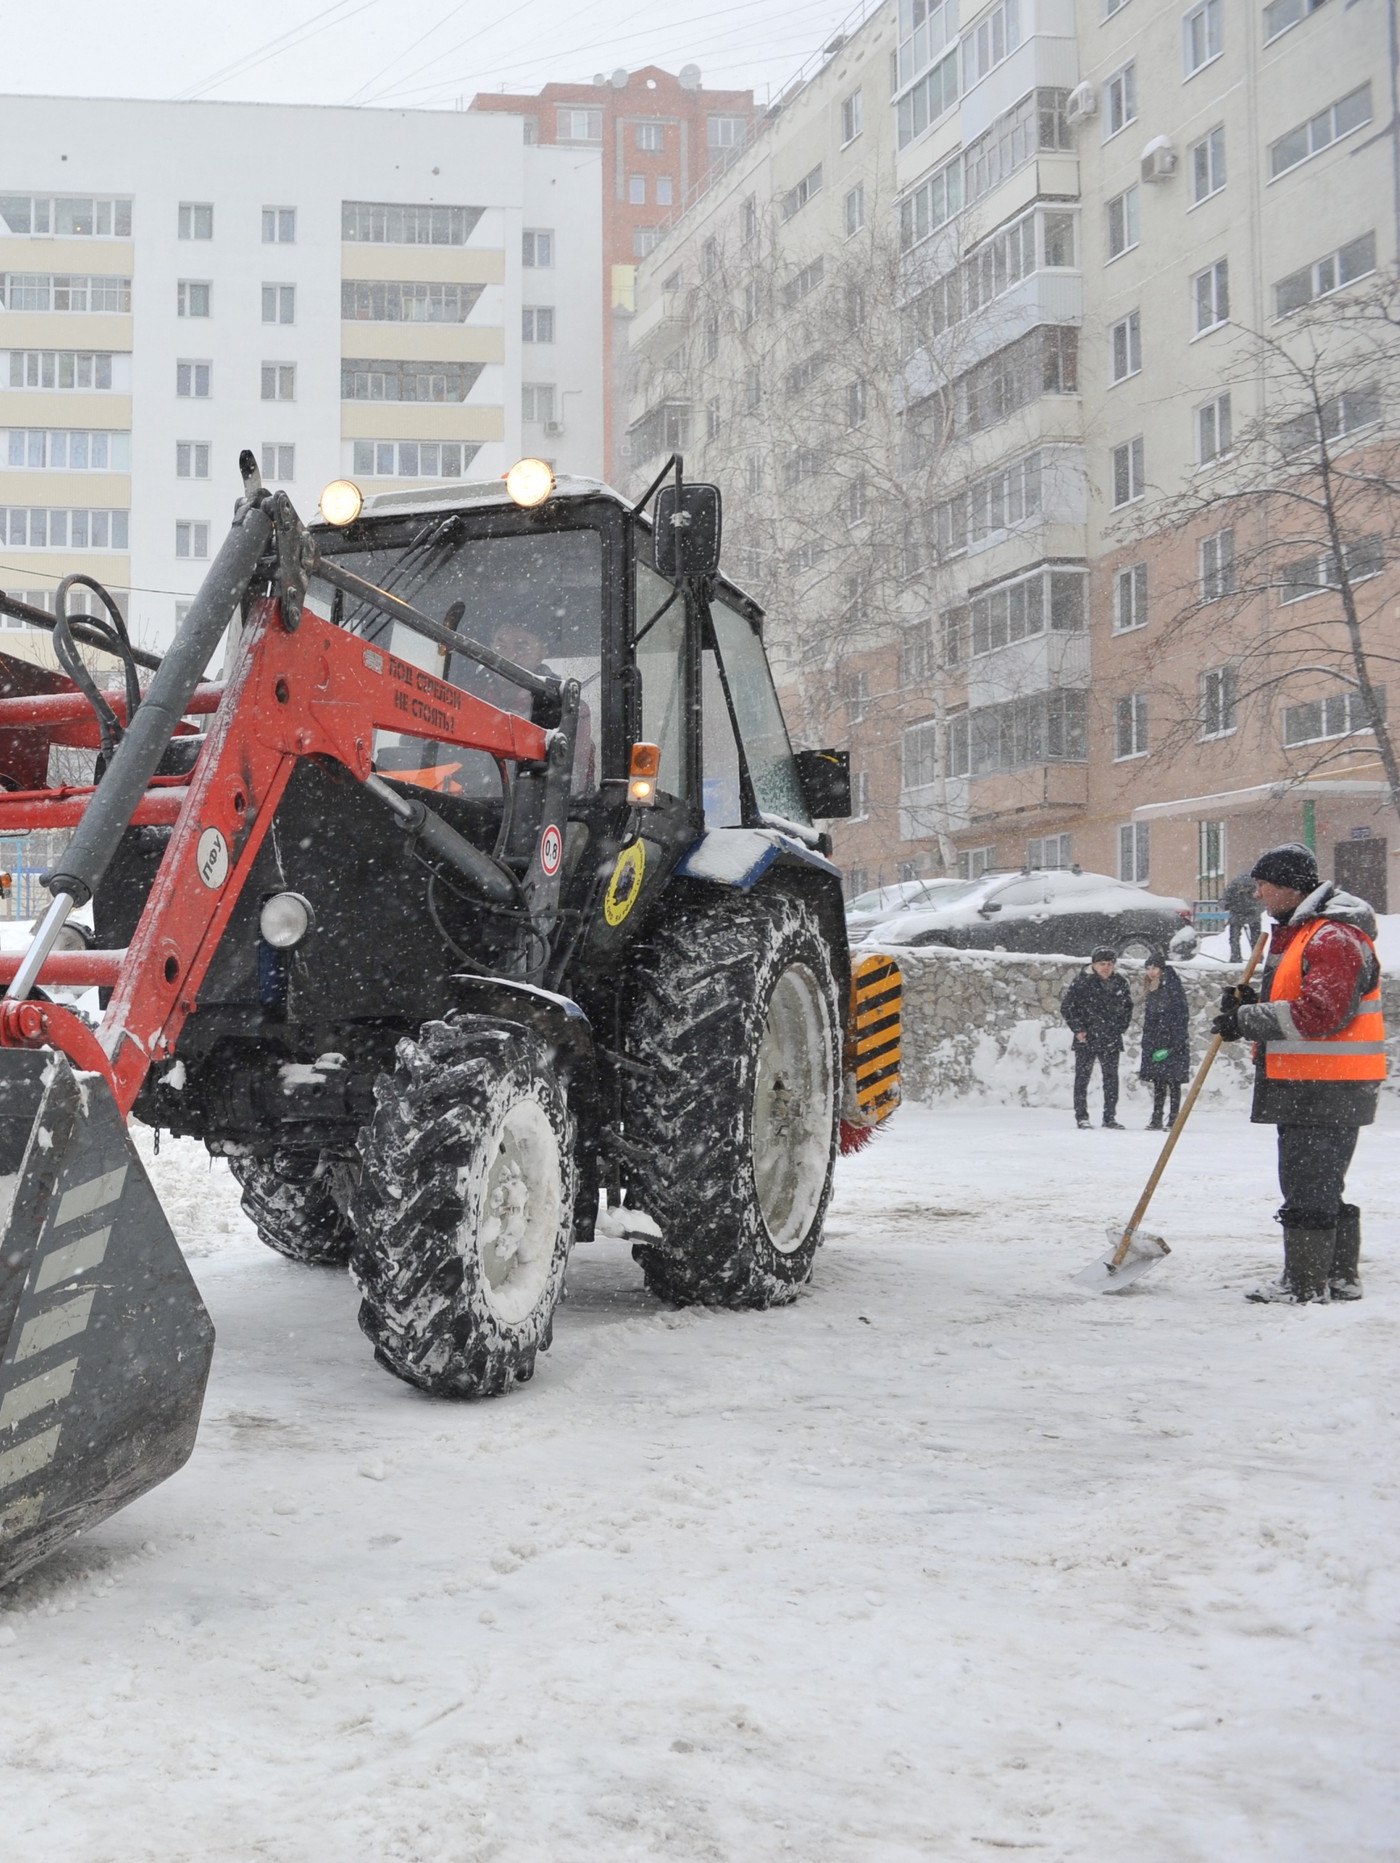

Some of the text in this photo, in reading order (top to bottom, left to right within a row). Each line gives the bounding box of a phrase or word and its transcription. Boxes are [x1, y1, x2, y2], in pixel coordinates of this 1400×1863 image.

[389, 658, 413, 686] ПОД
[395, 689, 454, 733] НЕ СТОЯТЬ!
[202, 834, 221, 881] ПФУ
[545, 840, 558, 861] 0,8
